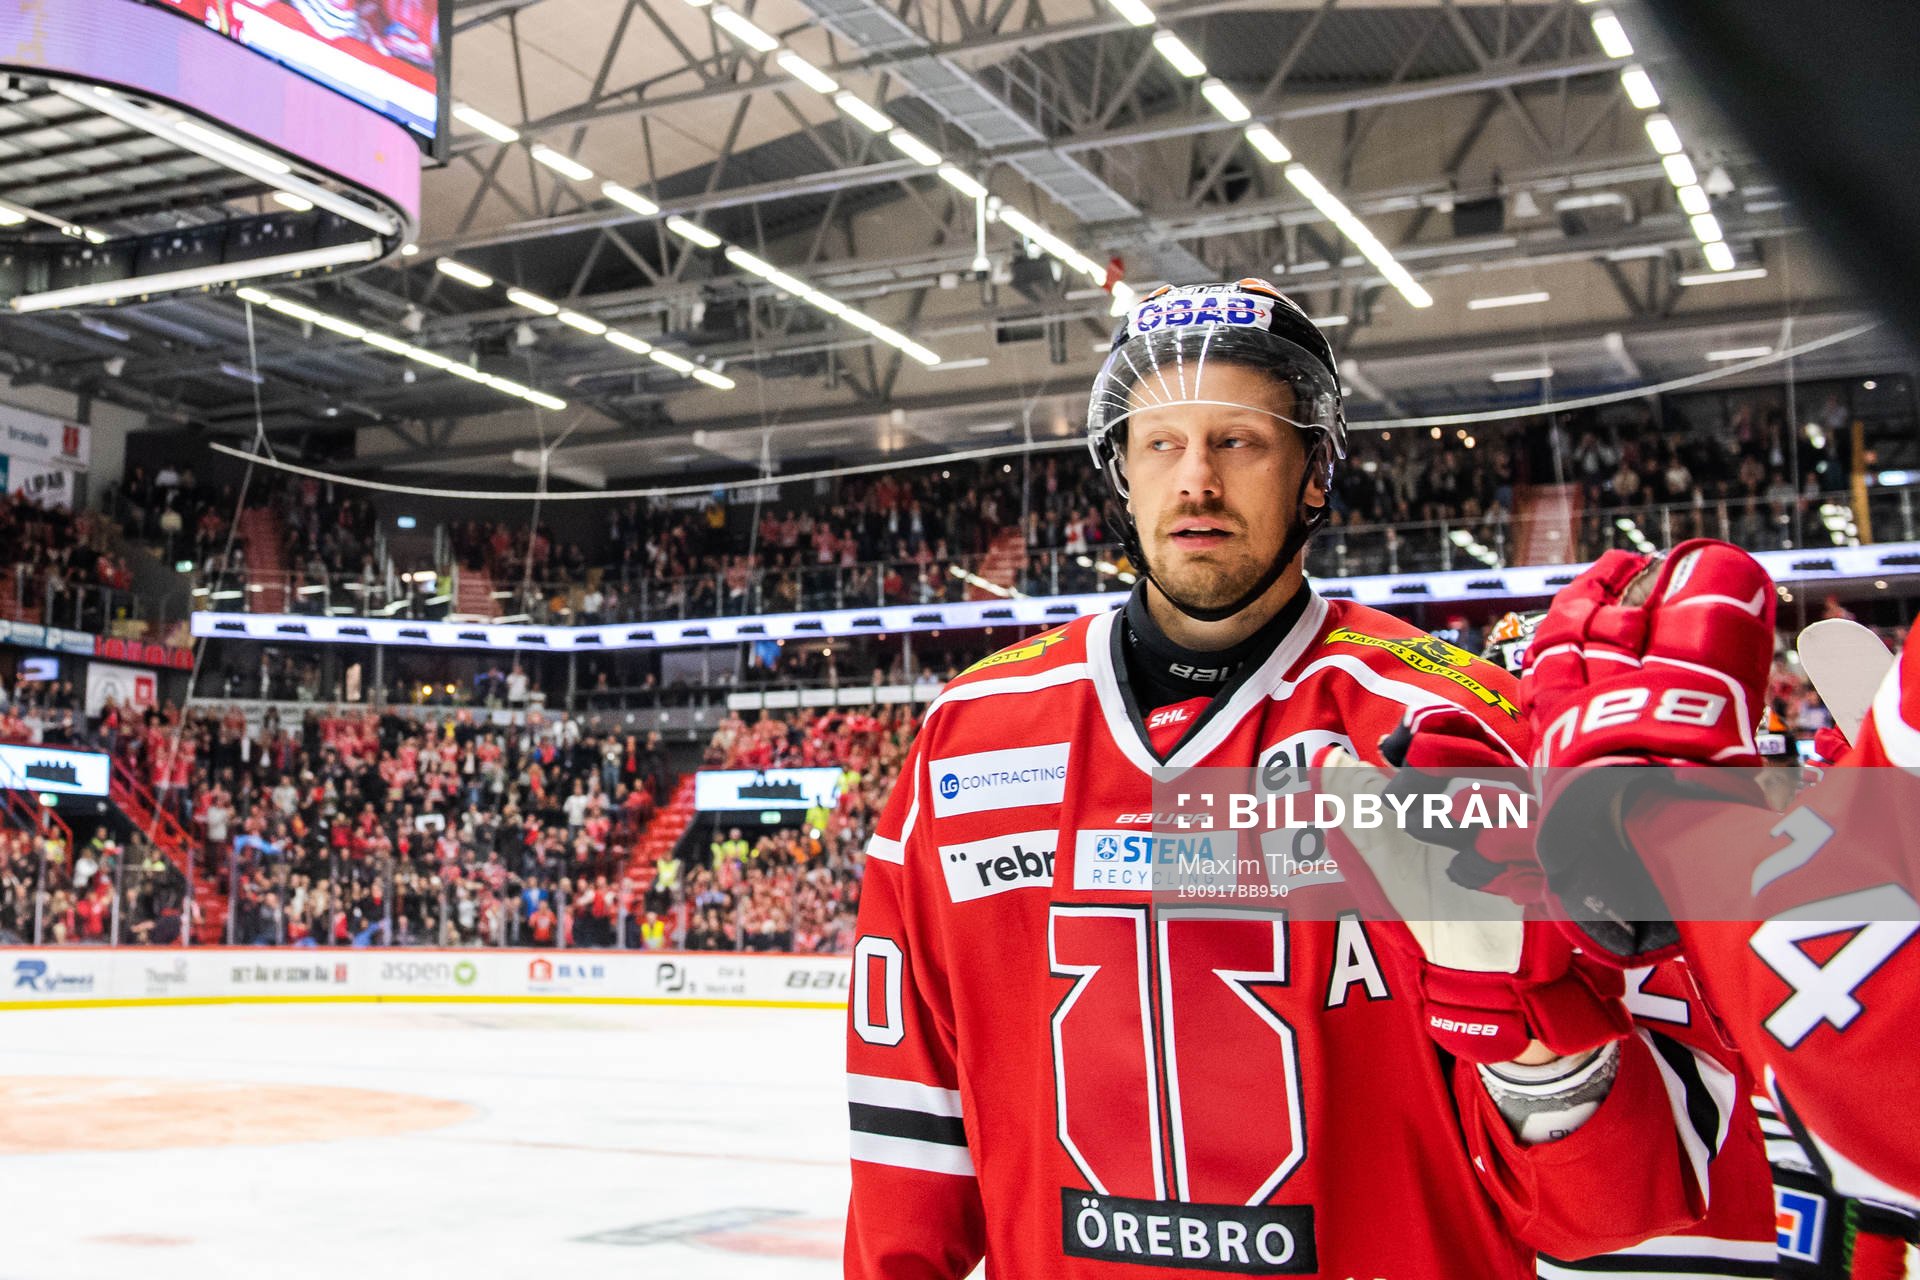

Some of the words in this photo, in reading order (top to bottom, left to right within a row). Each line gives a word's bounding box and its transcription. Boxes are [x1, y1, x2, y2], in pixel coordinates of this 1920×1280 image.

[1149, 709, 1187, 729] SHL
[961, 766, 1065, 790] CONTRACTING
[1123, 836, 1214, 864] STENA
[1092, 868, 1214, 885] RECYCLING
[1324, 908, 1391, 1009] A
[381, 960, 450, 984] aspen
[1076, 1198, 1295, 1265] ÖREBRO
